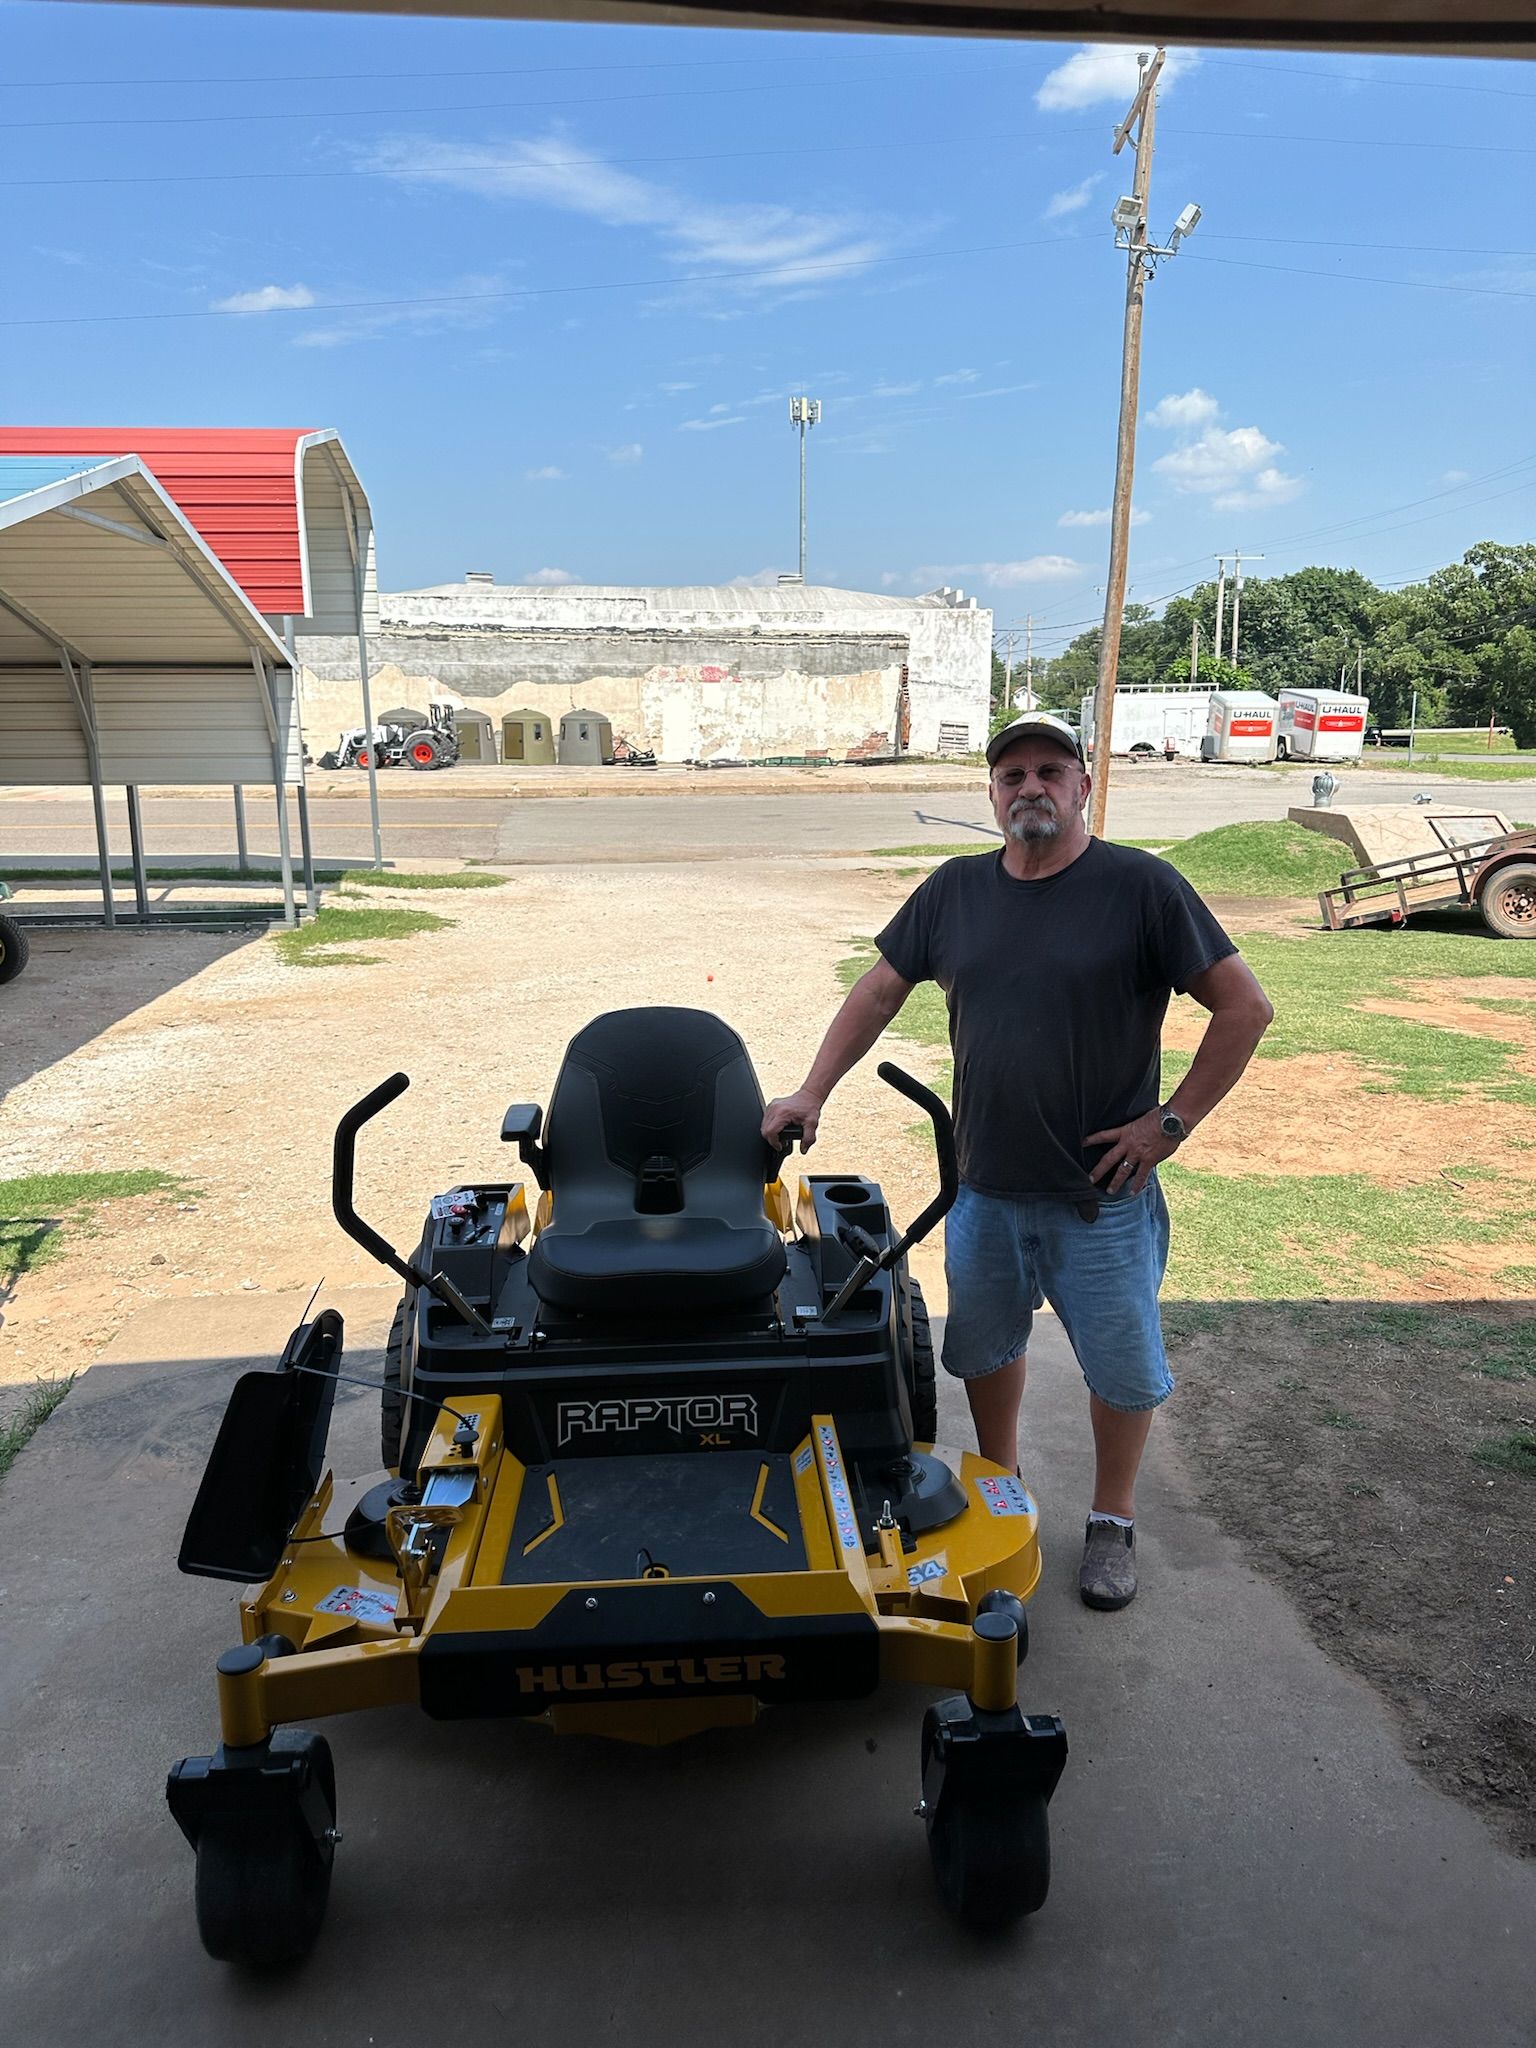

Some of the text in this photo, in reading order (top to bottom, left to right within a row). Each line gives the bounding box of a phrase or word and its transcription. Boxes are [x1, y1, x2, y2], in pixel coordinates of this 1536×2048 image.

[1322, 705, 1362, 714] U-HAUL
[557, 1394, 758, 1447] RAPTOR
[700, 1433, 731, 1445] XL
[515, 1654, 786, 1693] HUSTLER
